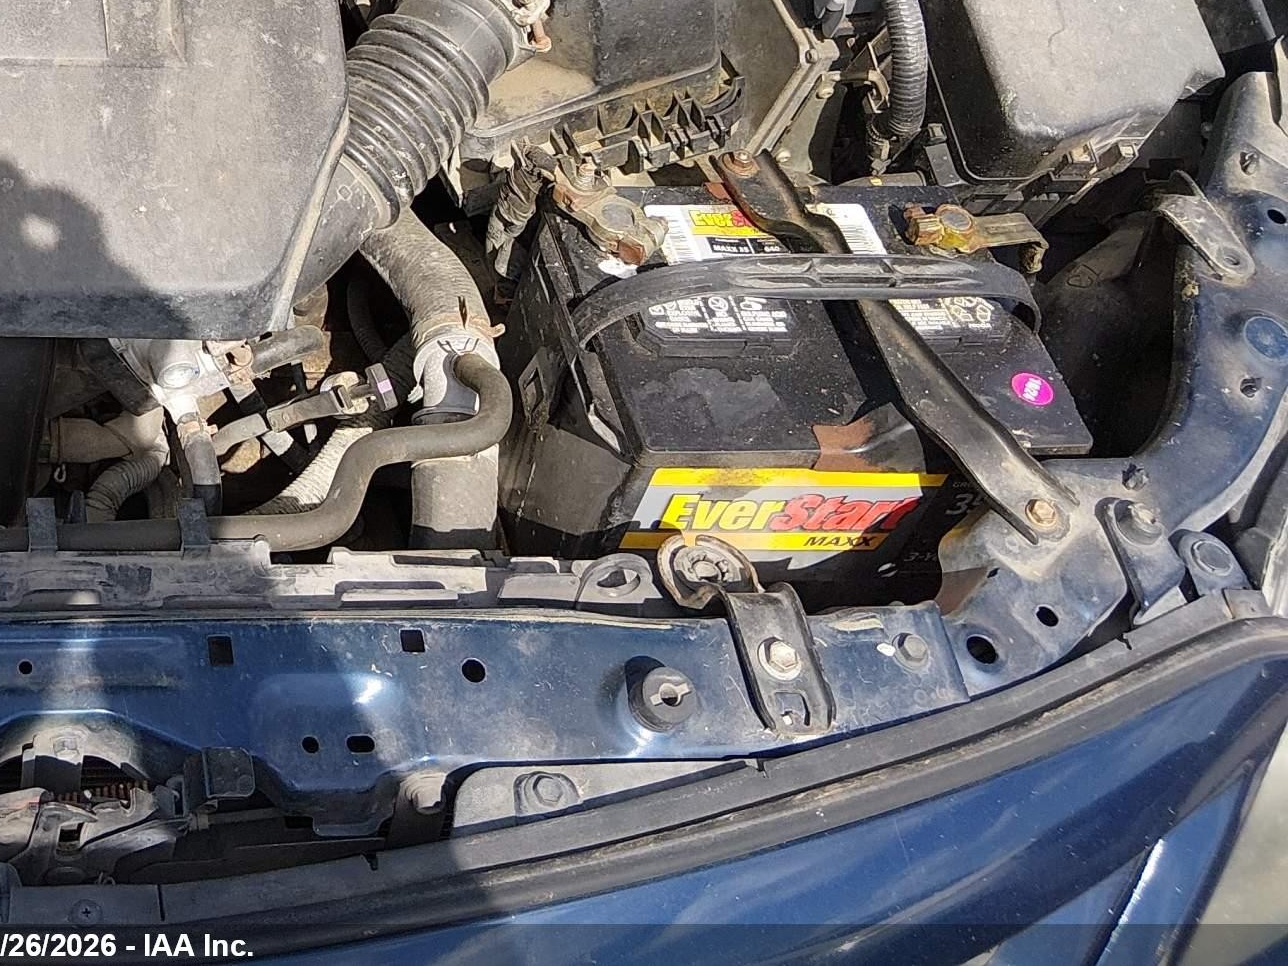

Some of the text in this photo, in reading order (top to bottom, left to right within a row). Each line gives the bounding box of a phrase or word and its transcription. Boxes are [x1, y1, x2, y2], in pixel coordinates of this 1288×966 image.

[688, 209, 754, 228] EverS
[661, 492, 920, 532] EverStart
[802, 535, 876, 548] MAXX
